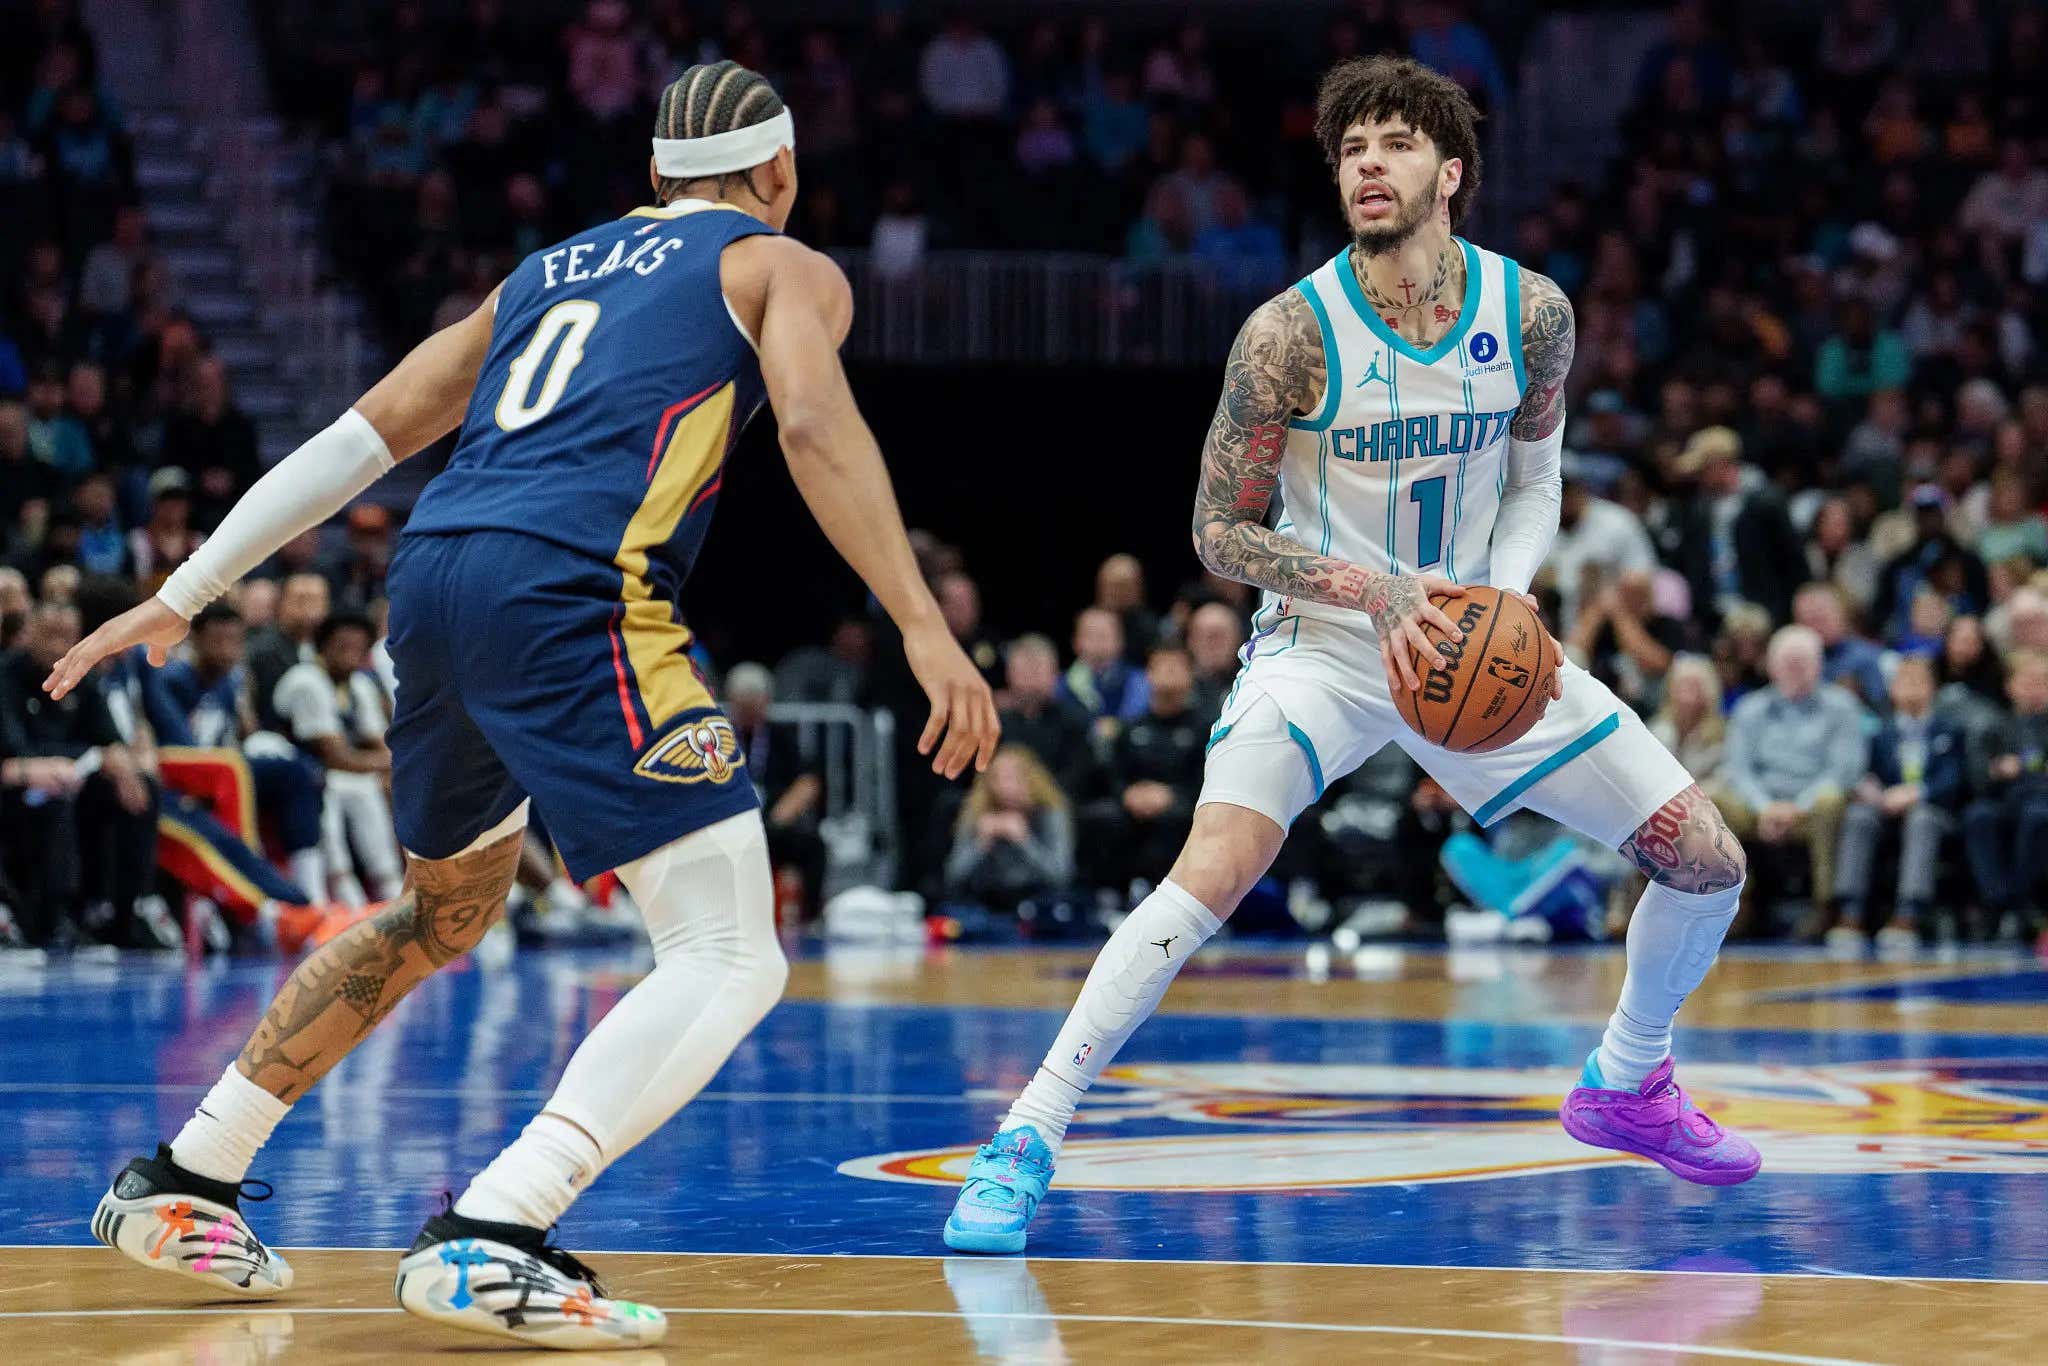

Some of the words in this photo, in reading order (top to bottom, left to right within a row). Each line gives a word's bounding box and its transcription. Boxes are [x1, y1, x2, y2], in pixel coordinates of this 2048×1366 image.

[495, 299, 600, 432] 0
[1463, 365, 1484, 378] Judi
[1484, 360, 1512, 374] Health
[1331, 406, 1518, 462] CHARLOTT
[1410, 475, 1446, 568] 1
